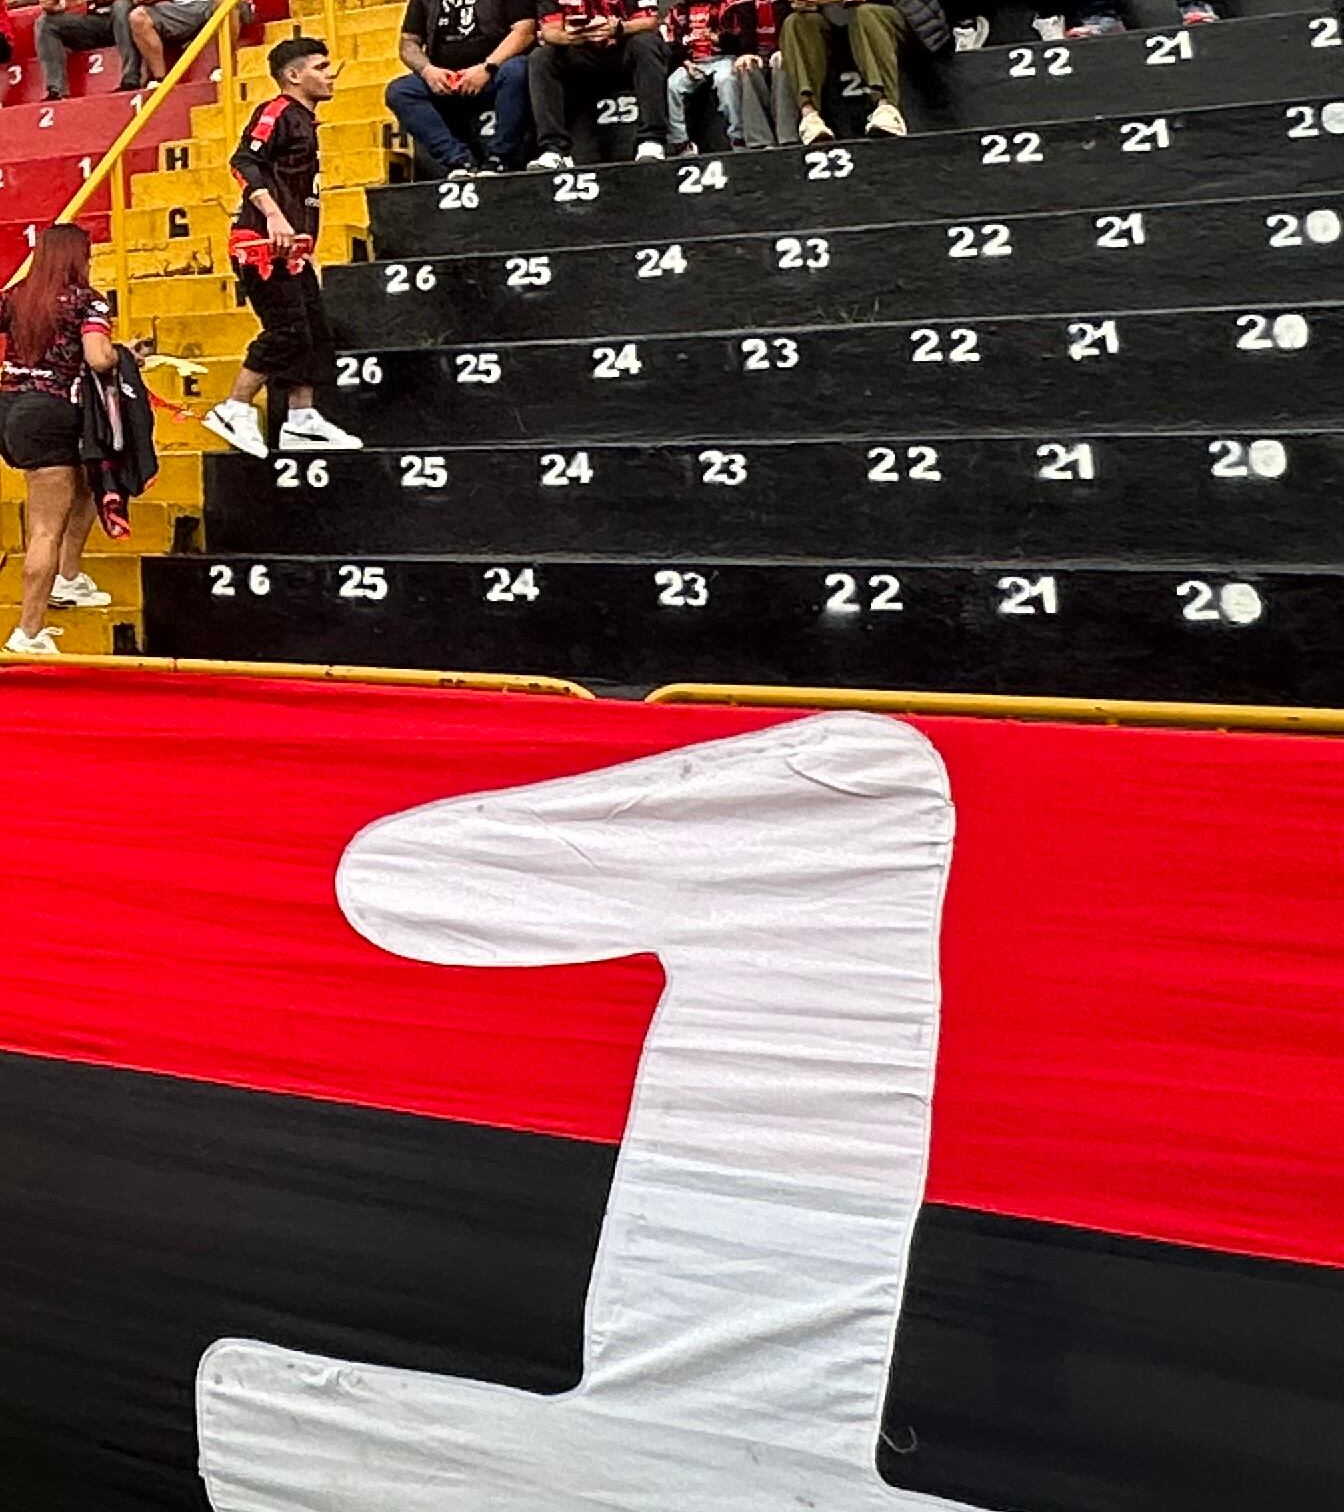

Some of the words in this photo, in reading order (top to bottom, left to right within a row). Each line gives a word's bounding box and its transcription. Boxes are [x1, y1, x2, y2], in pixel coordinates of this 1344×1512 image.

[1008, 46, 1073, 78] 22
[1145, 30, 1194, 65] 21
[38, 106, 54, 128] 2
[596, 96, 639, 124] 25
[78, 156, 92, 179] 1
[165, 146, 189, 171] H
[438, 182, 480, 210] 26
[552, 172, 600, 202] 25
[677, 160, 728, 194] 24
[804, 148, 854, 180] 23
[980, 132, 1044, 164] 22
[1120, 118, 1170, 152] 21
[22, 224, 37, 248] 1
[384, 264, 436, 294] 26
[504, 256, 552, 286] 25
[634, 244, 688, 278] 24
[775, 237, 830, 269] 23
[948, 224, 1012, 258] 22
[1096, 212, 1146, 248] 21
[336, 356, 383, 386] 26
[455, 352, 502, 384] 25
[592, 343, 642, 378] 24
[741, 338, 800, 370] 23
[910, 328, 981, 362] 22
[1068, 320, 1120, 361] 21
[274, 458, 330, 488] 26
[400, 454, 448, 488] 25
[540, 452, 594, 486] 24
[698, 450, 748, 486] 23
[867, 446, 942, 482] 22
[1036, 442, 1094, 480] 21
[208, 564, 270, 596] 26
[338, 564, 388, 600] 25
[483, 567, 540, 602] 24
[654, 570, 708, 607] 23
[824, 572, 904, 615] 22
[998, 576, 1057, 614] 21
